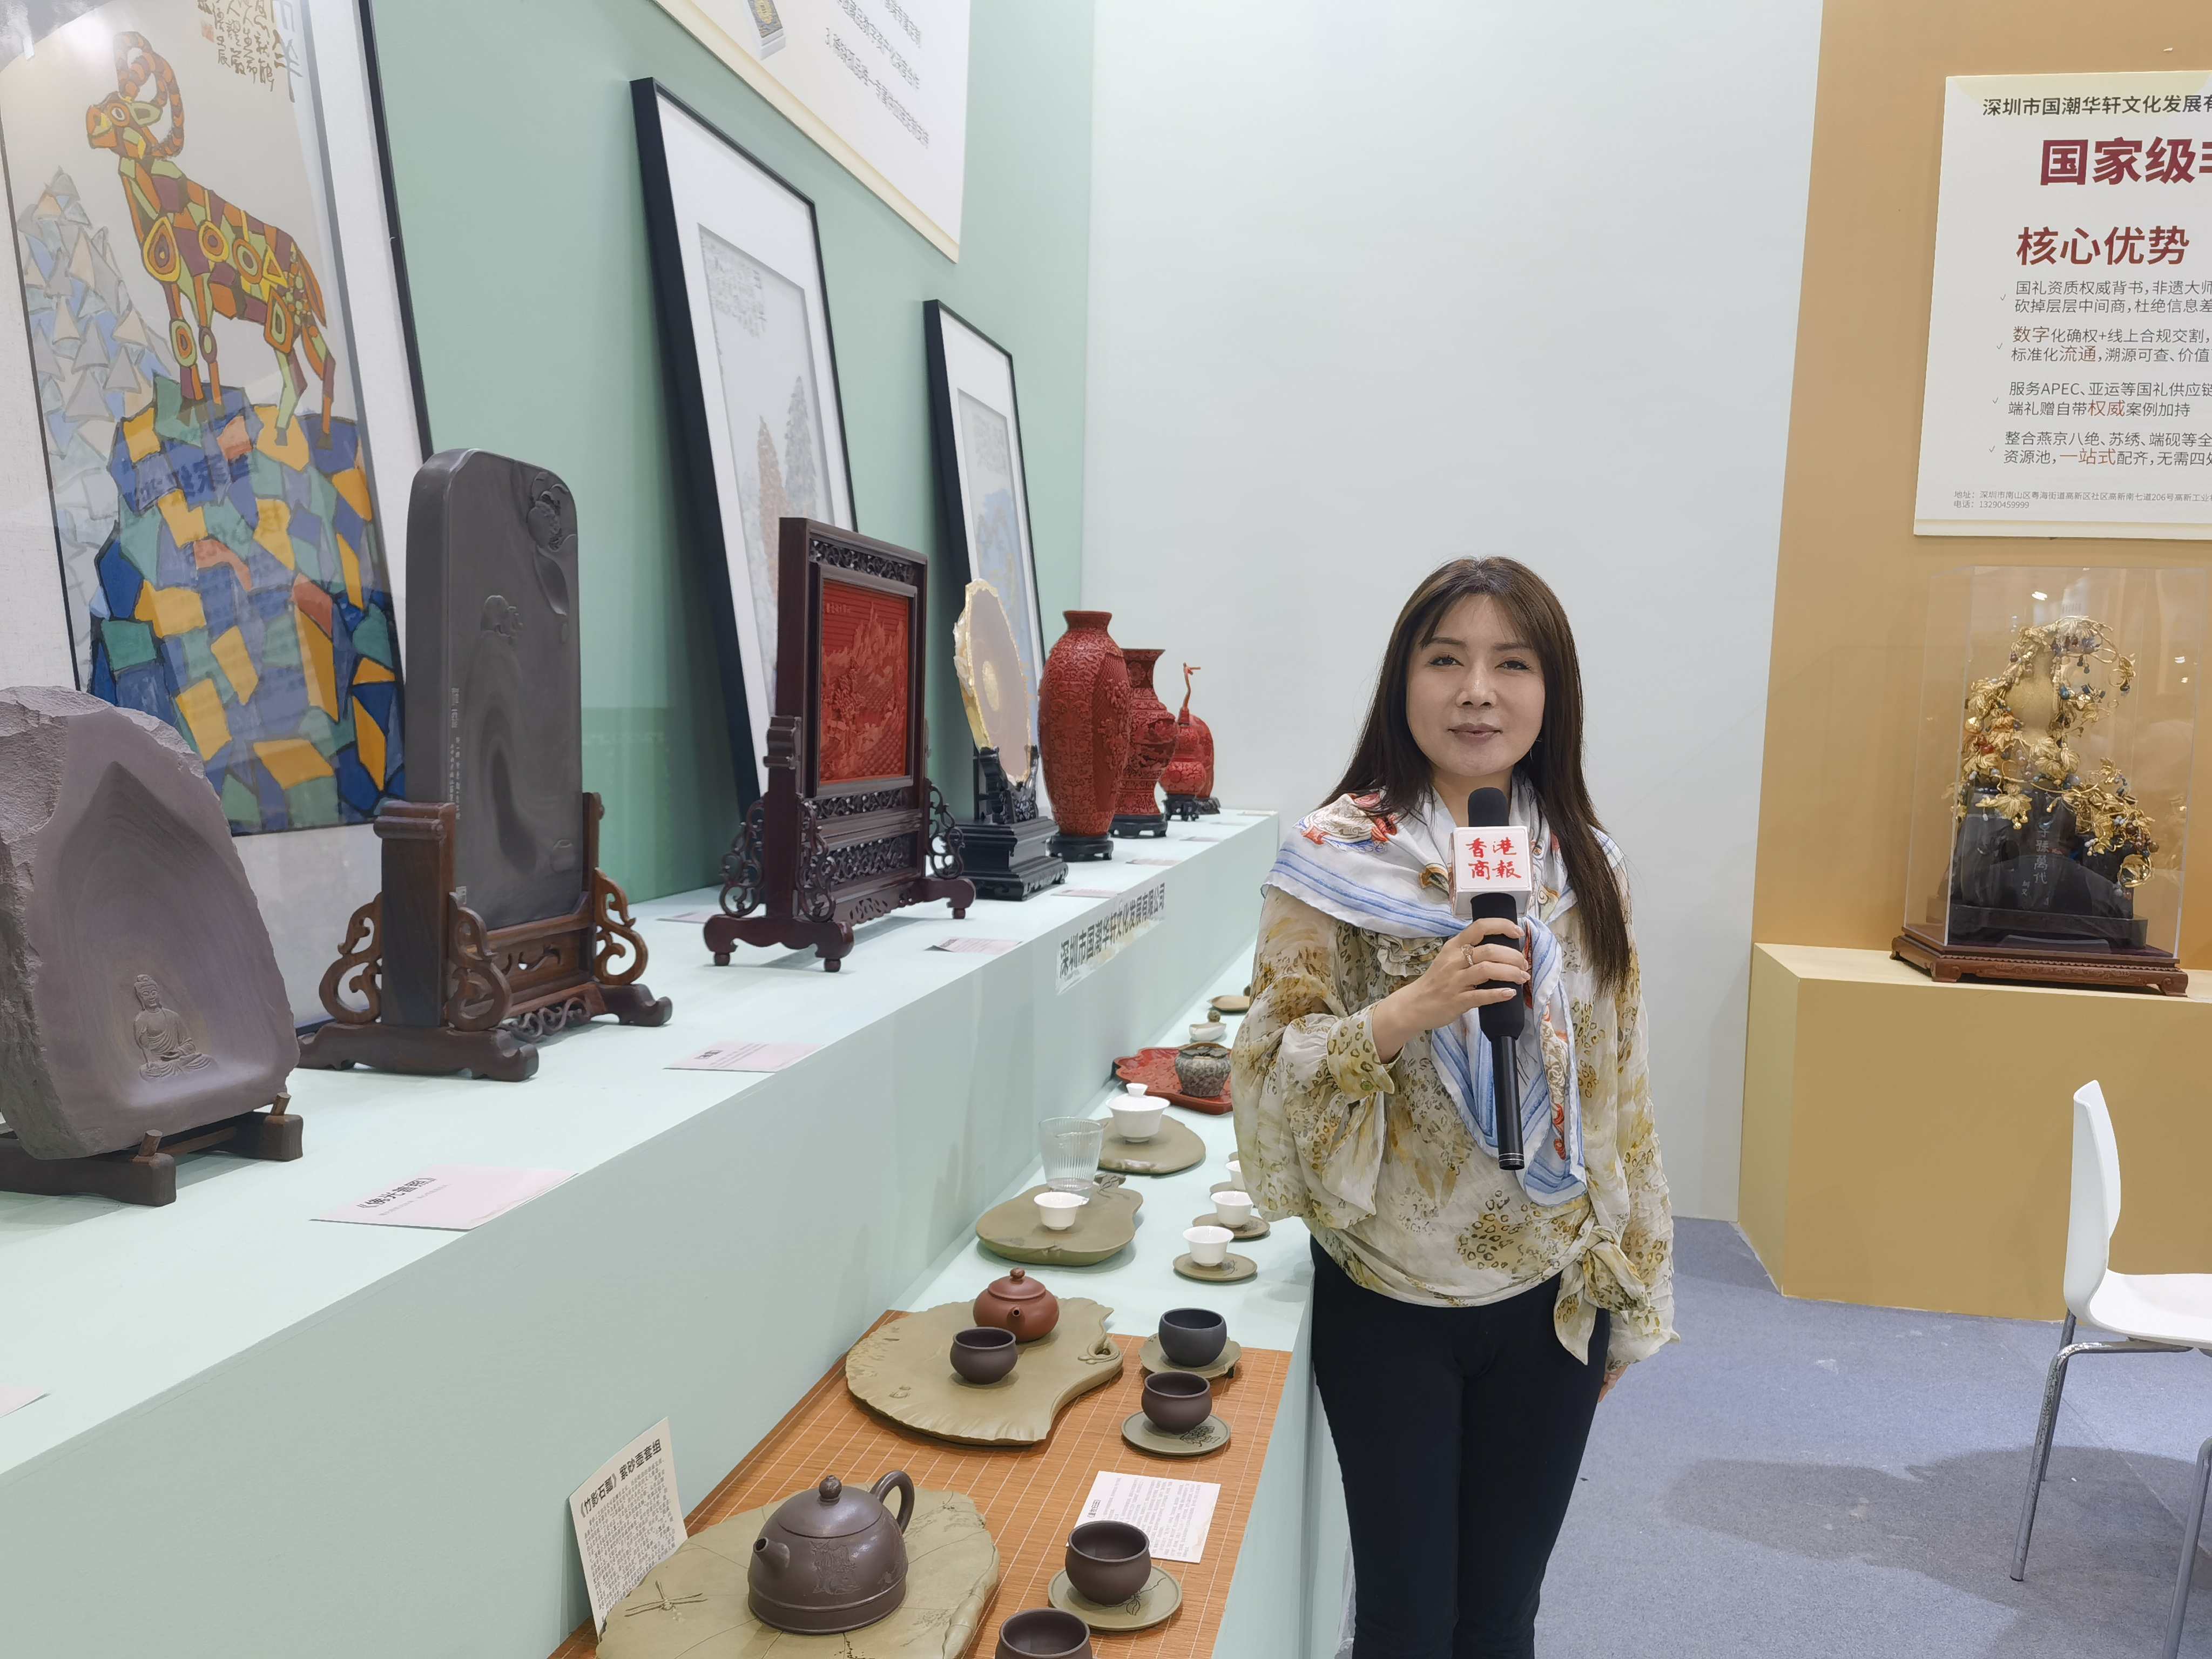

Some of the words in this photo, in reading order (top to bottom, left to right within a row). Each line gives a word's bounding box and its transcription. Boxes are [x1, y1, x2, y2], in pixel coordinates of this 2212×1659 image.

[2017, 226, 2189, 265] 核心优势
[2011, 345, 2212, 362] 标准化流通，溯源可查、价值
[2008, 400, 2190, 417] 端礼赠自带权威案例加持
[1465, 837, 1517, 858] 香港
[1468, 860, 1521, 880] 商報
[1060, 882, 1165, 978] 深圳市国潮华轩文化发展有限公司
